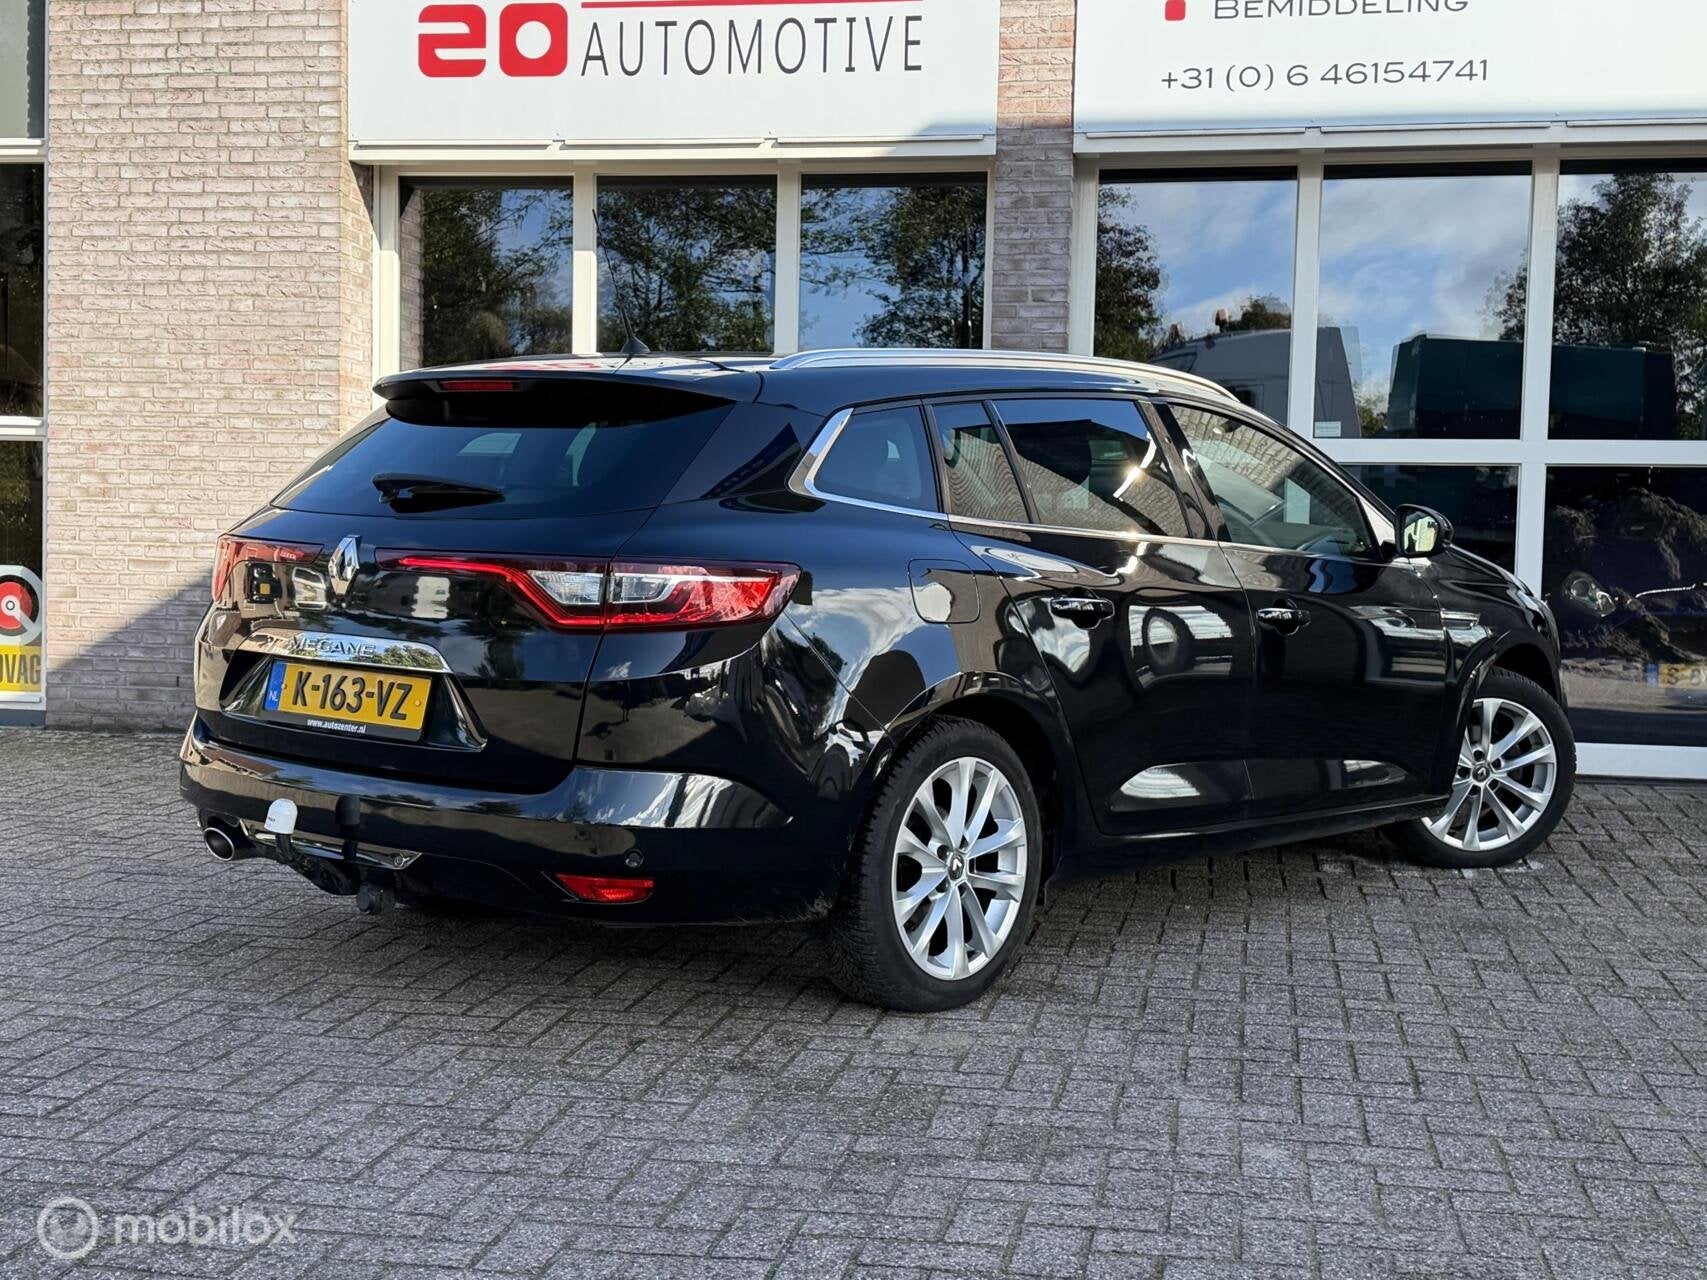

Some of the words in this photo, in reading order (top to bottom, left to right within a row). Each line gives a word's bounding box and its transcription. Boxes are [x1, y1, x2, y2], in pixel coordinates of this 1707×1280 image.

[1214, 0, 1469, 19] BEMIDDELING
[581, 15, 923, 76] AUTOMOTIVE
[1161, 67, 1213, 89] +31
[1226, 64, 1274, 92] (0)
[1286, 64, 1309, 86] 6
[1320, 59, 1488, 85] 46154741
[288, 636, 376, 657] MEGANE
[268, 690, 278, 702] NL
[292, 670, 413, 720] K-163-VZ
[306, 718, 367, 734] www.autozenter.nl
